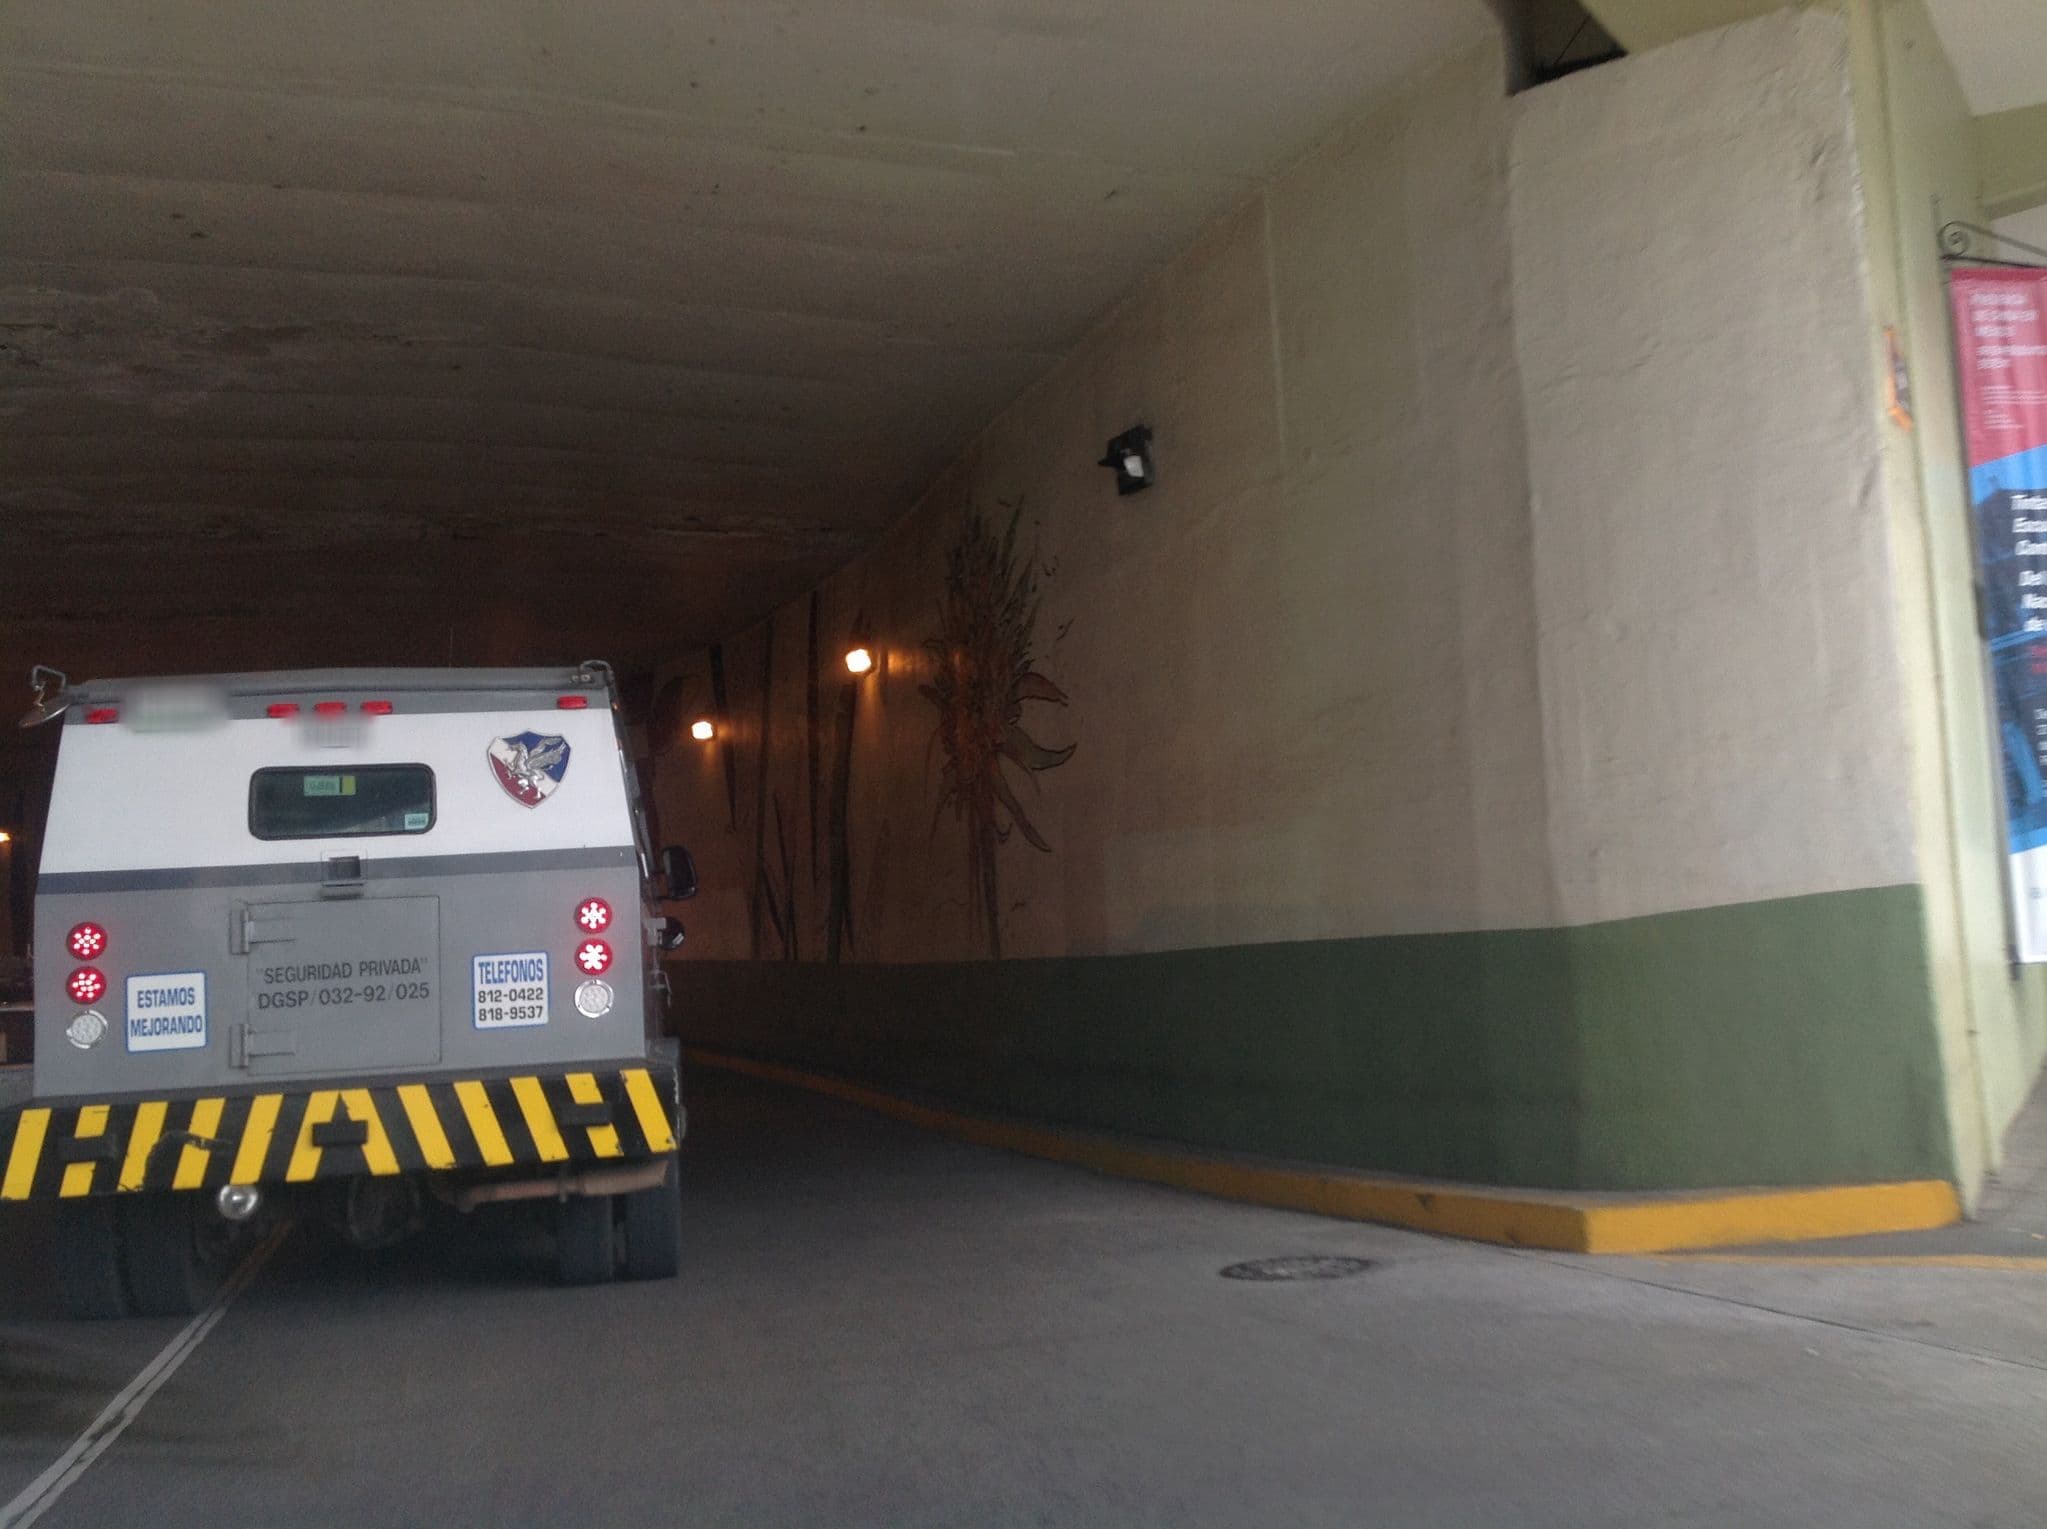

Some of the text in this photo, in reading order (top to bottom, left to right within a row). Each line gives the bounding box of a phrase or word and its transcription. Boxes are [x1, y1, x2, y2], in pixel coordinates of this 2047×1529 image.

[478, 958, 544, 985] TELEFONOS
[137, 987, 195, 1008] ESTAMOS
[478, 987, 544, 1004] 812-0422
[478, 1005, 544, 1022] 818-9537
[130, 1014, 203, 1037] MEJORANDO
